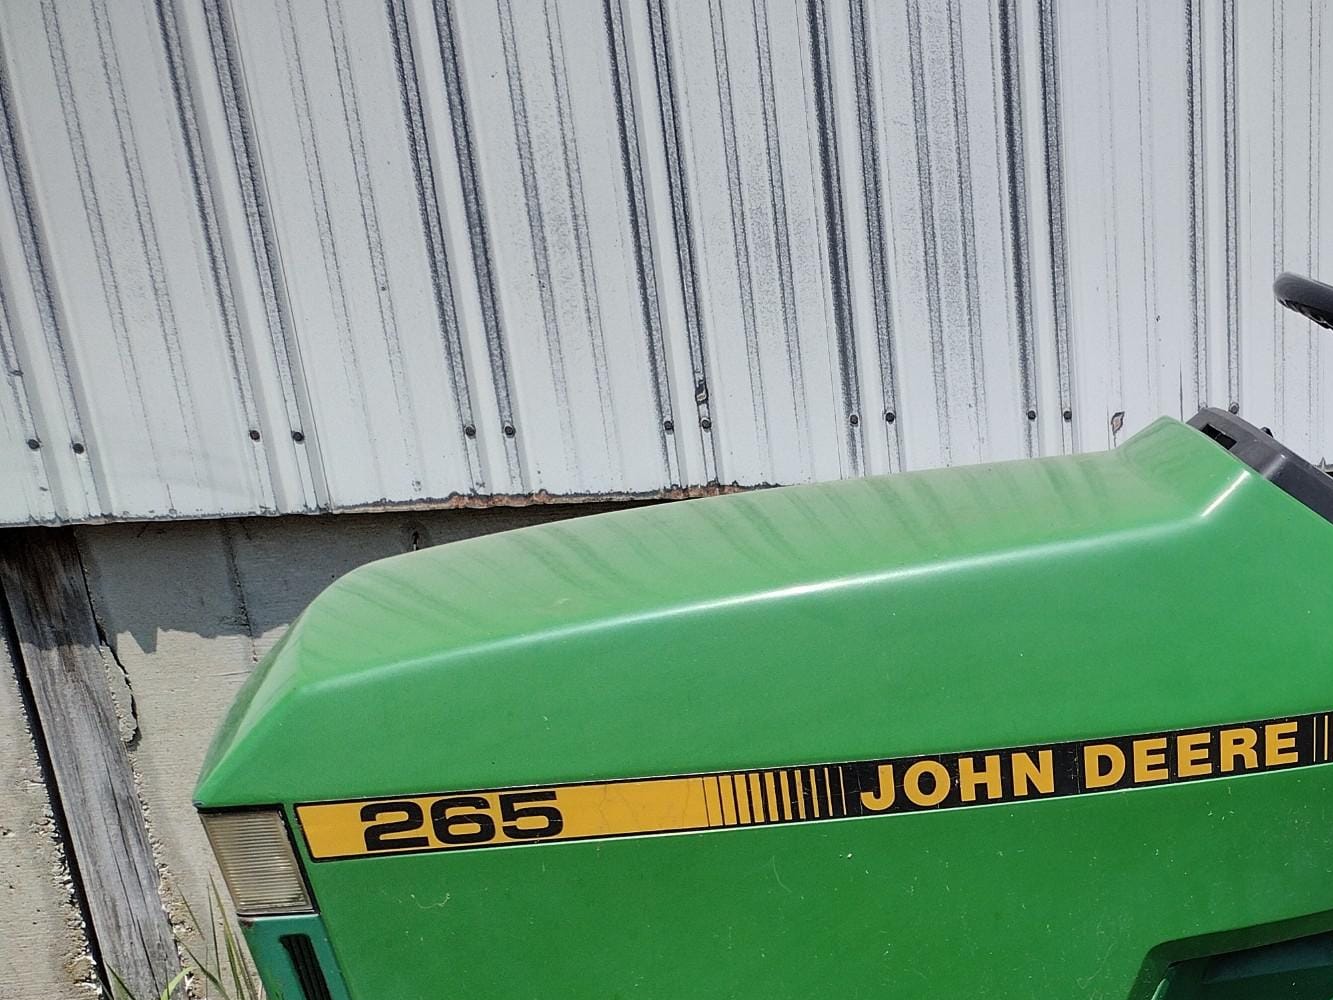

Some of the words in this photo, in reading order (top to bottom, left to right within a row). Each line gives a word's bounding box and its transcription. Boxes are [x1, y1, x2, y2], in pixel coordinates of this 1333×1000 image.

[359, 791, 563, 851] 265
[860, 749, 1055, 811] JOHN
[1083, 721, 1299, 789] DEERE
